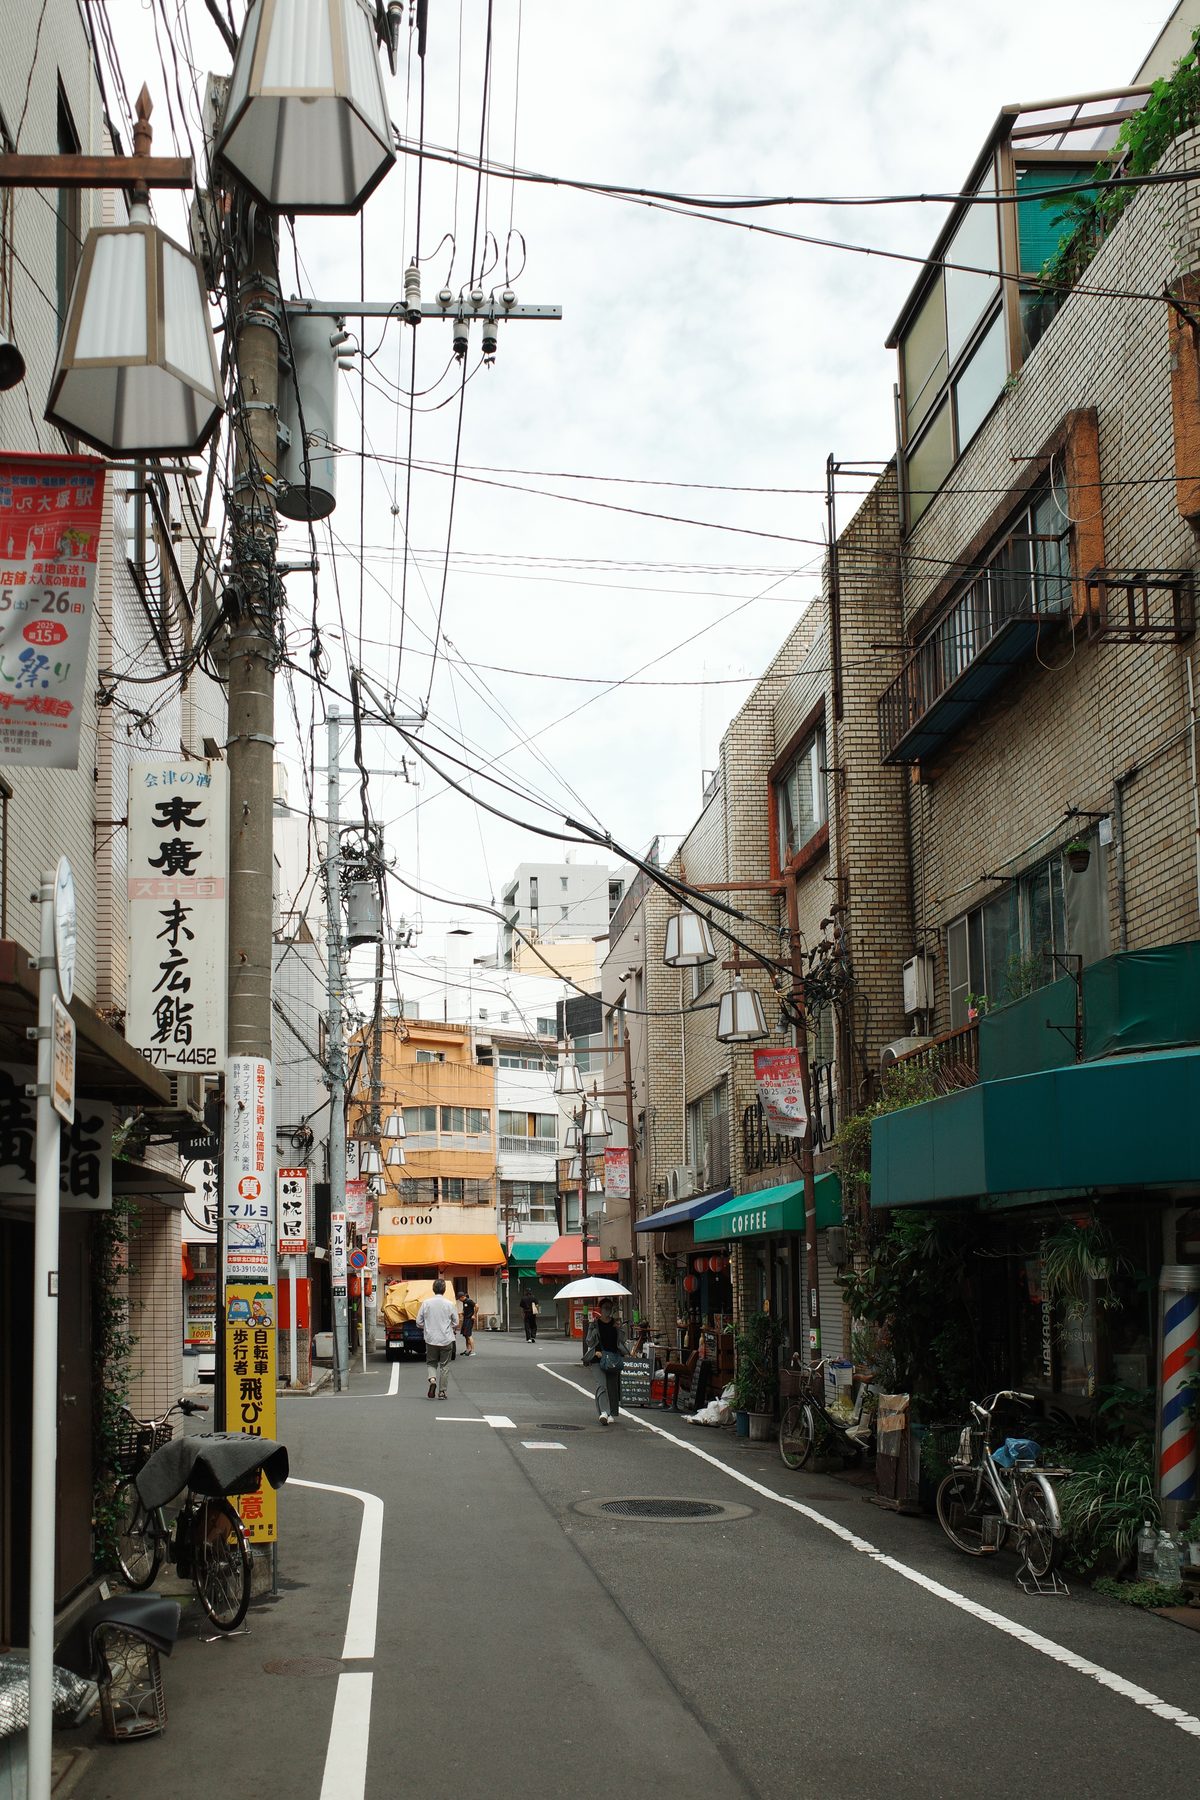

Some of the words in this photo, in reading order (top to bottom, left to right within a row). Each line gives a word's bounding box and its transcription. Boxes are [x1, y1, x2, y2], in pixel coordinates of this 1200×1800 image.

[16, 487, 94, 512] JR大塚駅
[36, 622, 54, 630] 2025
[144, 770, 212, 788] 会津の酒
[135, 881, 216, 896] スエヒロ
[150, 898, 196, 1046] 末広鮨
[228, 1204, 268, 1217] マルヨ
[392, 1216, 432, 1225] GOTOO
[732, 1211, 767, 1233] COFFEE
[334, 1224, 344, 1257] マルヨ
[192, 1330, 211, 1338] 100円
[233, 1329, 249, 1376] 歩行者
[253, 1329, 269, 1375] 自転車
